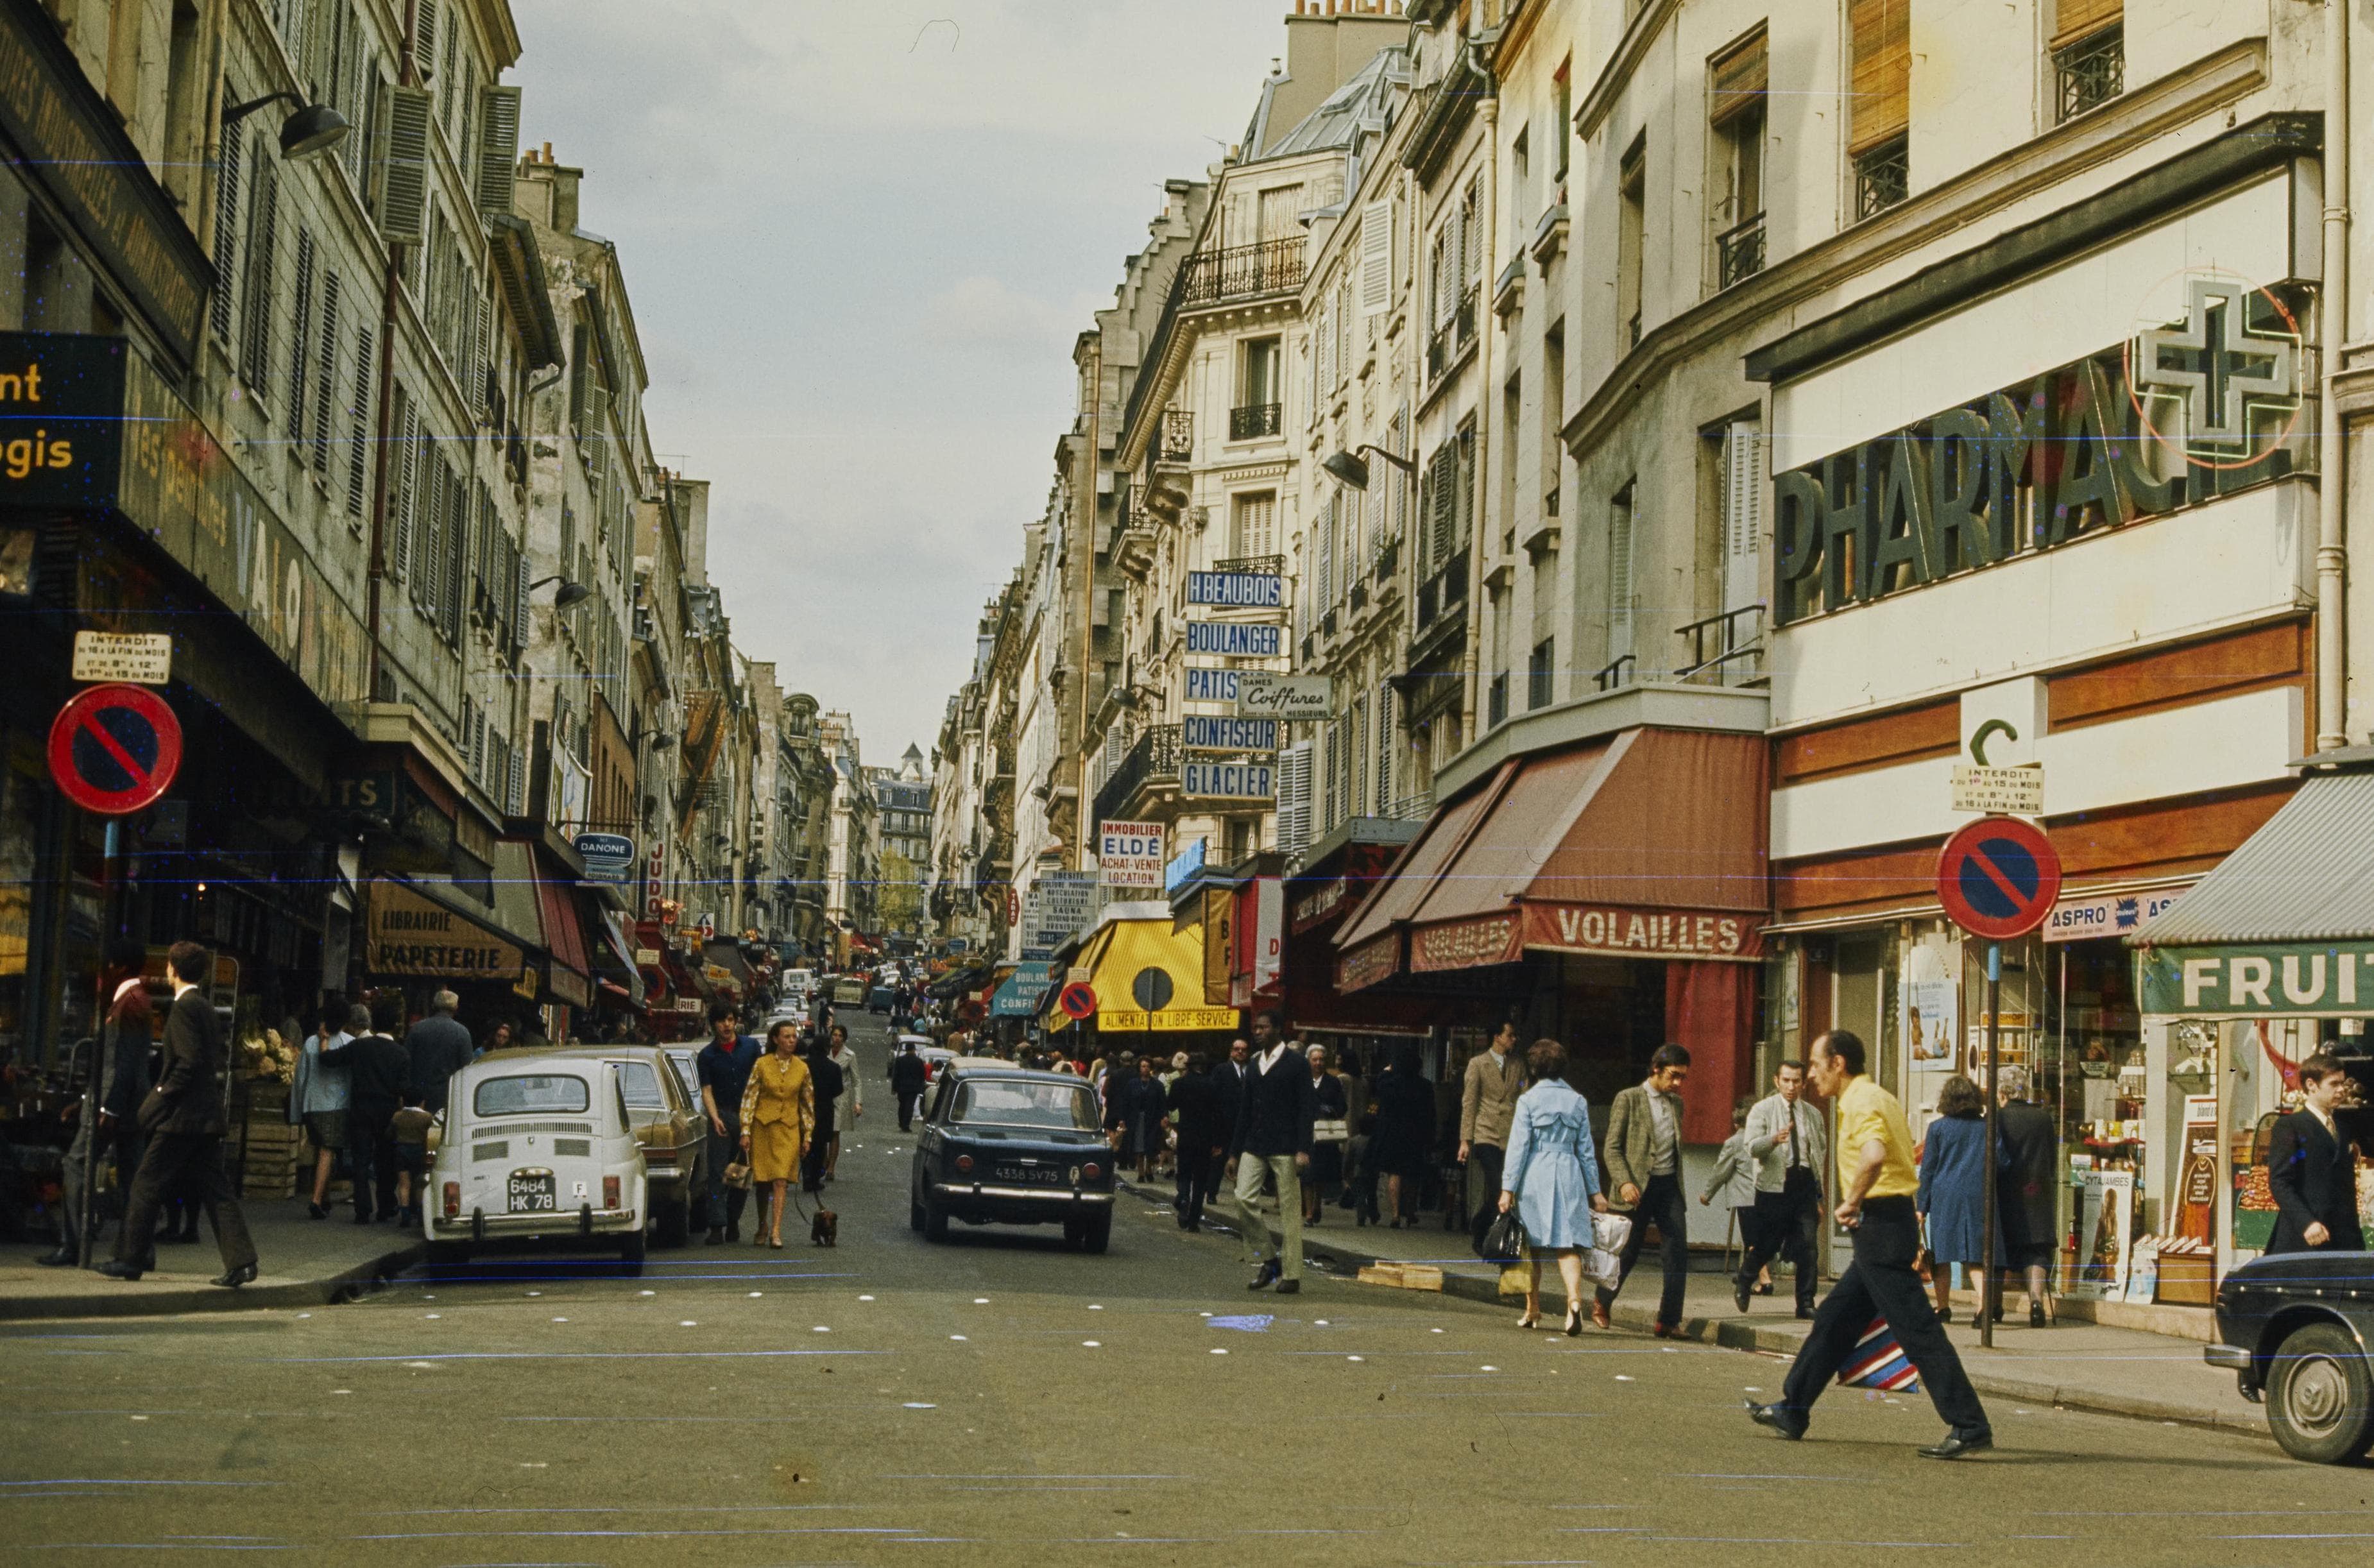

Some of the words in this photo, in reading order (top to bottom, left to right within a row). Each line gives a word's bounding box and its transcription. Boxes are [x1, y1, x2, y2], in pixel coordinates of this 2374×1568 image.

[0, 429, 72, 479] gis
[1774, 350, 2292, 626] PHARMAC
[91, 636, 157, 645] INTERDIT
[1188, 623, 1279, 654] BOULANGER
[1247, 687, 1324, 710] Coiffures
[1184, 717, 1276, 749] CONFISEUR
[1187, 765, 1269, 796] GLACIER
[1968, 769, 2031, 778] INTERDIT
[1102, 823, 1162, 836] IMMOBILIER
[581, 843, 625, 854] DANONE
[647, 842, 663, 914] JUDO
[1109, 872, 1154, 884] LOCATION
[383, 910, 451, 932] LIBRAIRIE
[1558, 909, 1739, 954] VOLAILLES
[380, 944, 500, 969] PAPETERIE
[678, 1000, 695, 1009] RIE
[1106, 1013, 1163, 1027] ALIMENTATON
[511, 1179, 546, 1193] 6484
[577, 1184, 583, 1194] F
[511, 1195, 528, 1211] HK
[534, 1194, 552, 1209] 78
